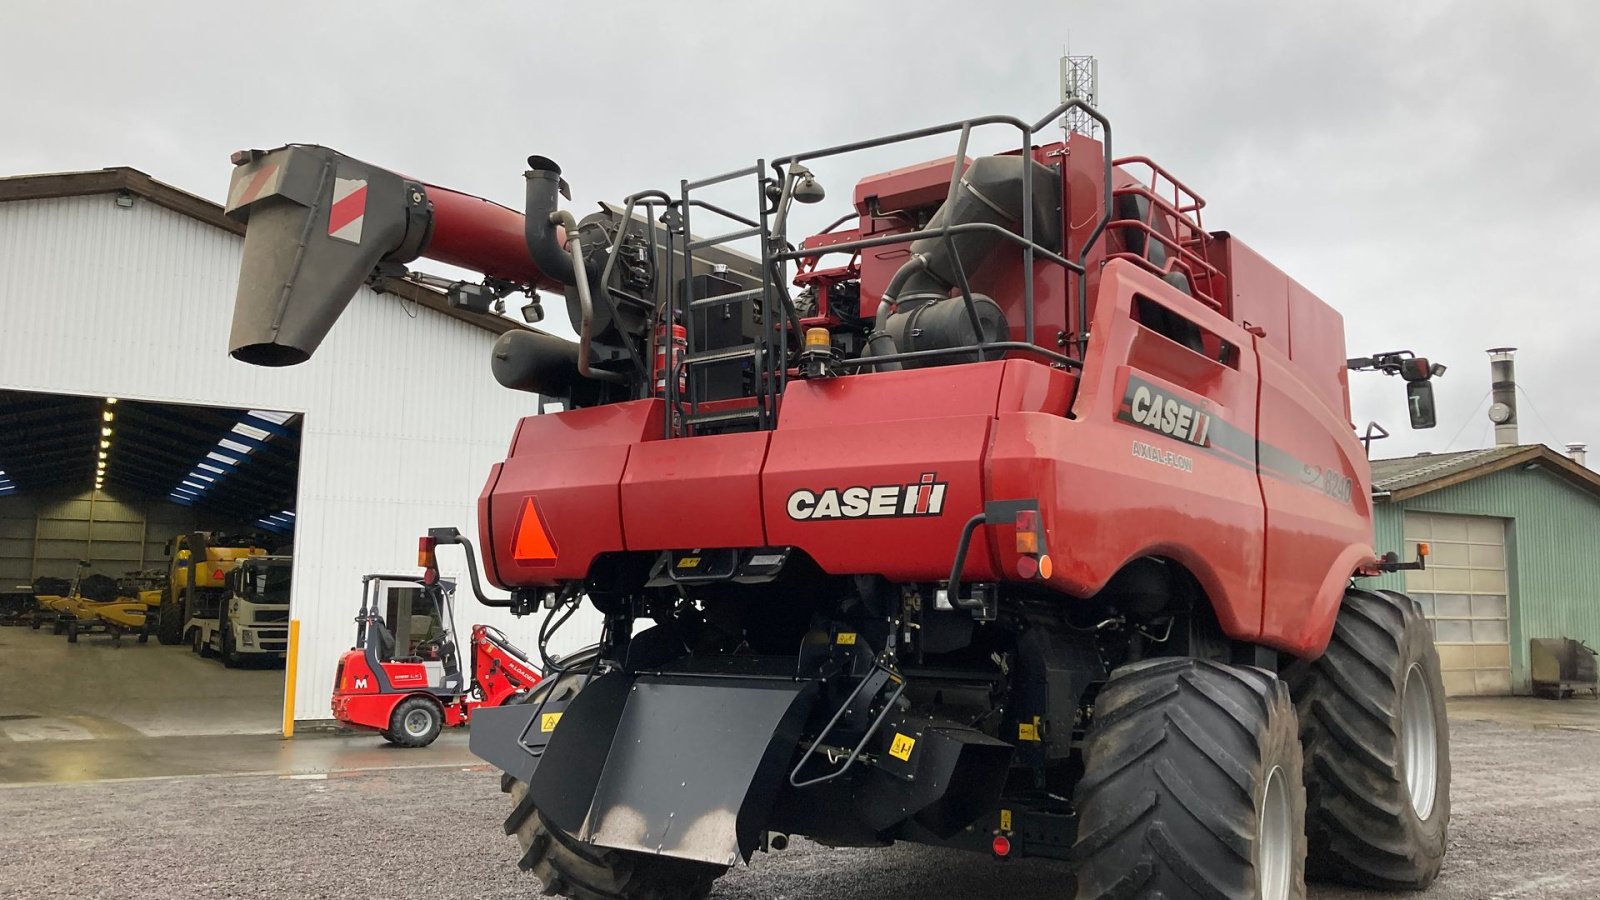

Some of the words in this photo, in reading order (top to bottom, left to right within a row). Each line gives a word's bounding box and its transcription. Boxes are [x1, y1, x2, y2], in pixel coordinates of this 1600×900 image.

[1131, 386, 1193, 440] CASE
[1132, 440, 1193, 473] AXIAL-FLOW
[1323, 468, 1352, 503] 8240
[787, 487, 900, 520] CASE
